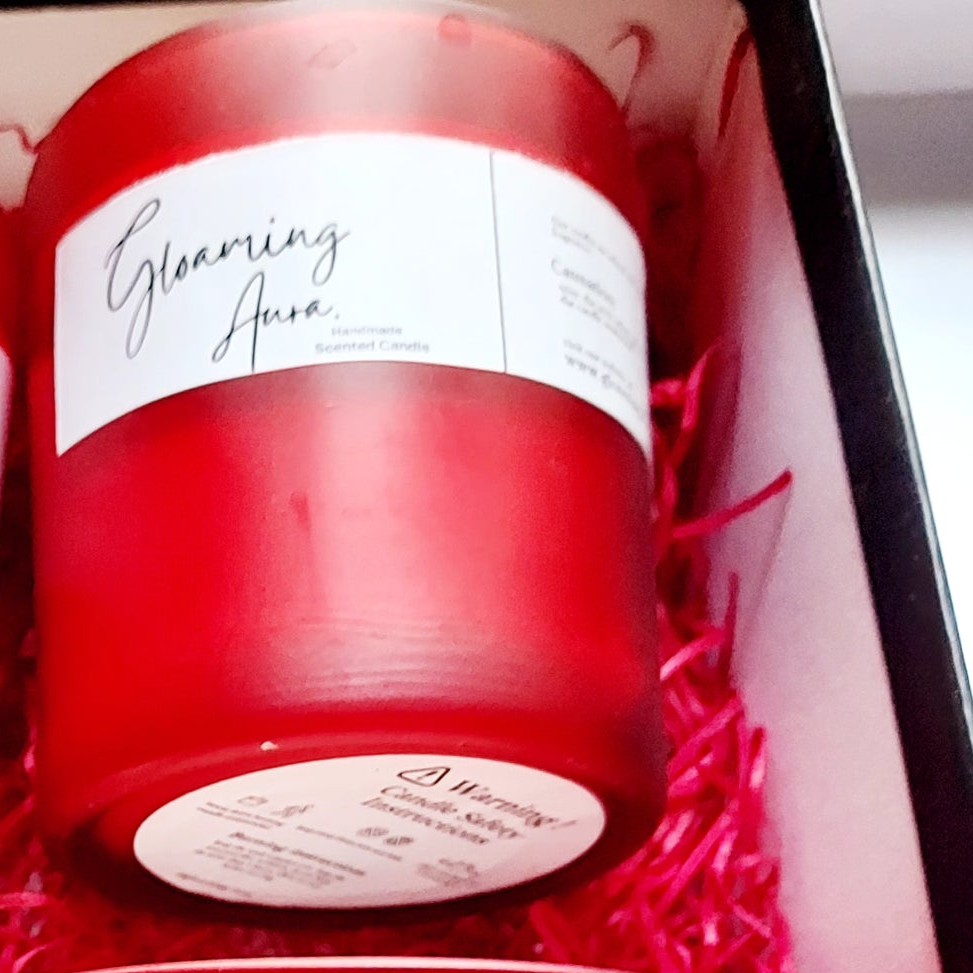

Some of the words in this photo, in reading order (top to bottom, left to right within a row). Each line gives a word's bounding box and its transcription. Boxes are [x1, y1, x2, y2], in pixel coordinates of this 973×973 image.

[106, 198, 351, 360] Gloaming
[212, 271, 340, 373] Aura.
[314, 341, 376, 355] Scented
[378, 339, 431, 354] Candle
